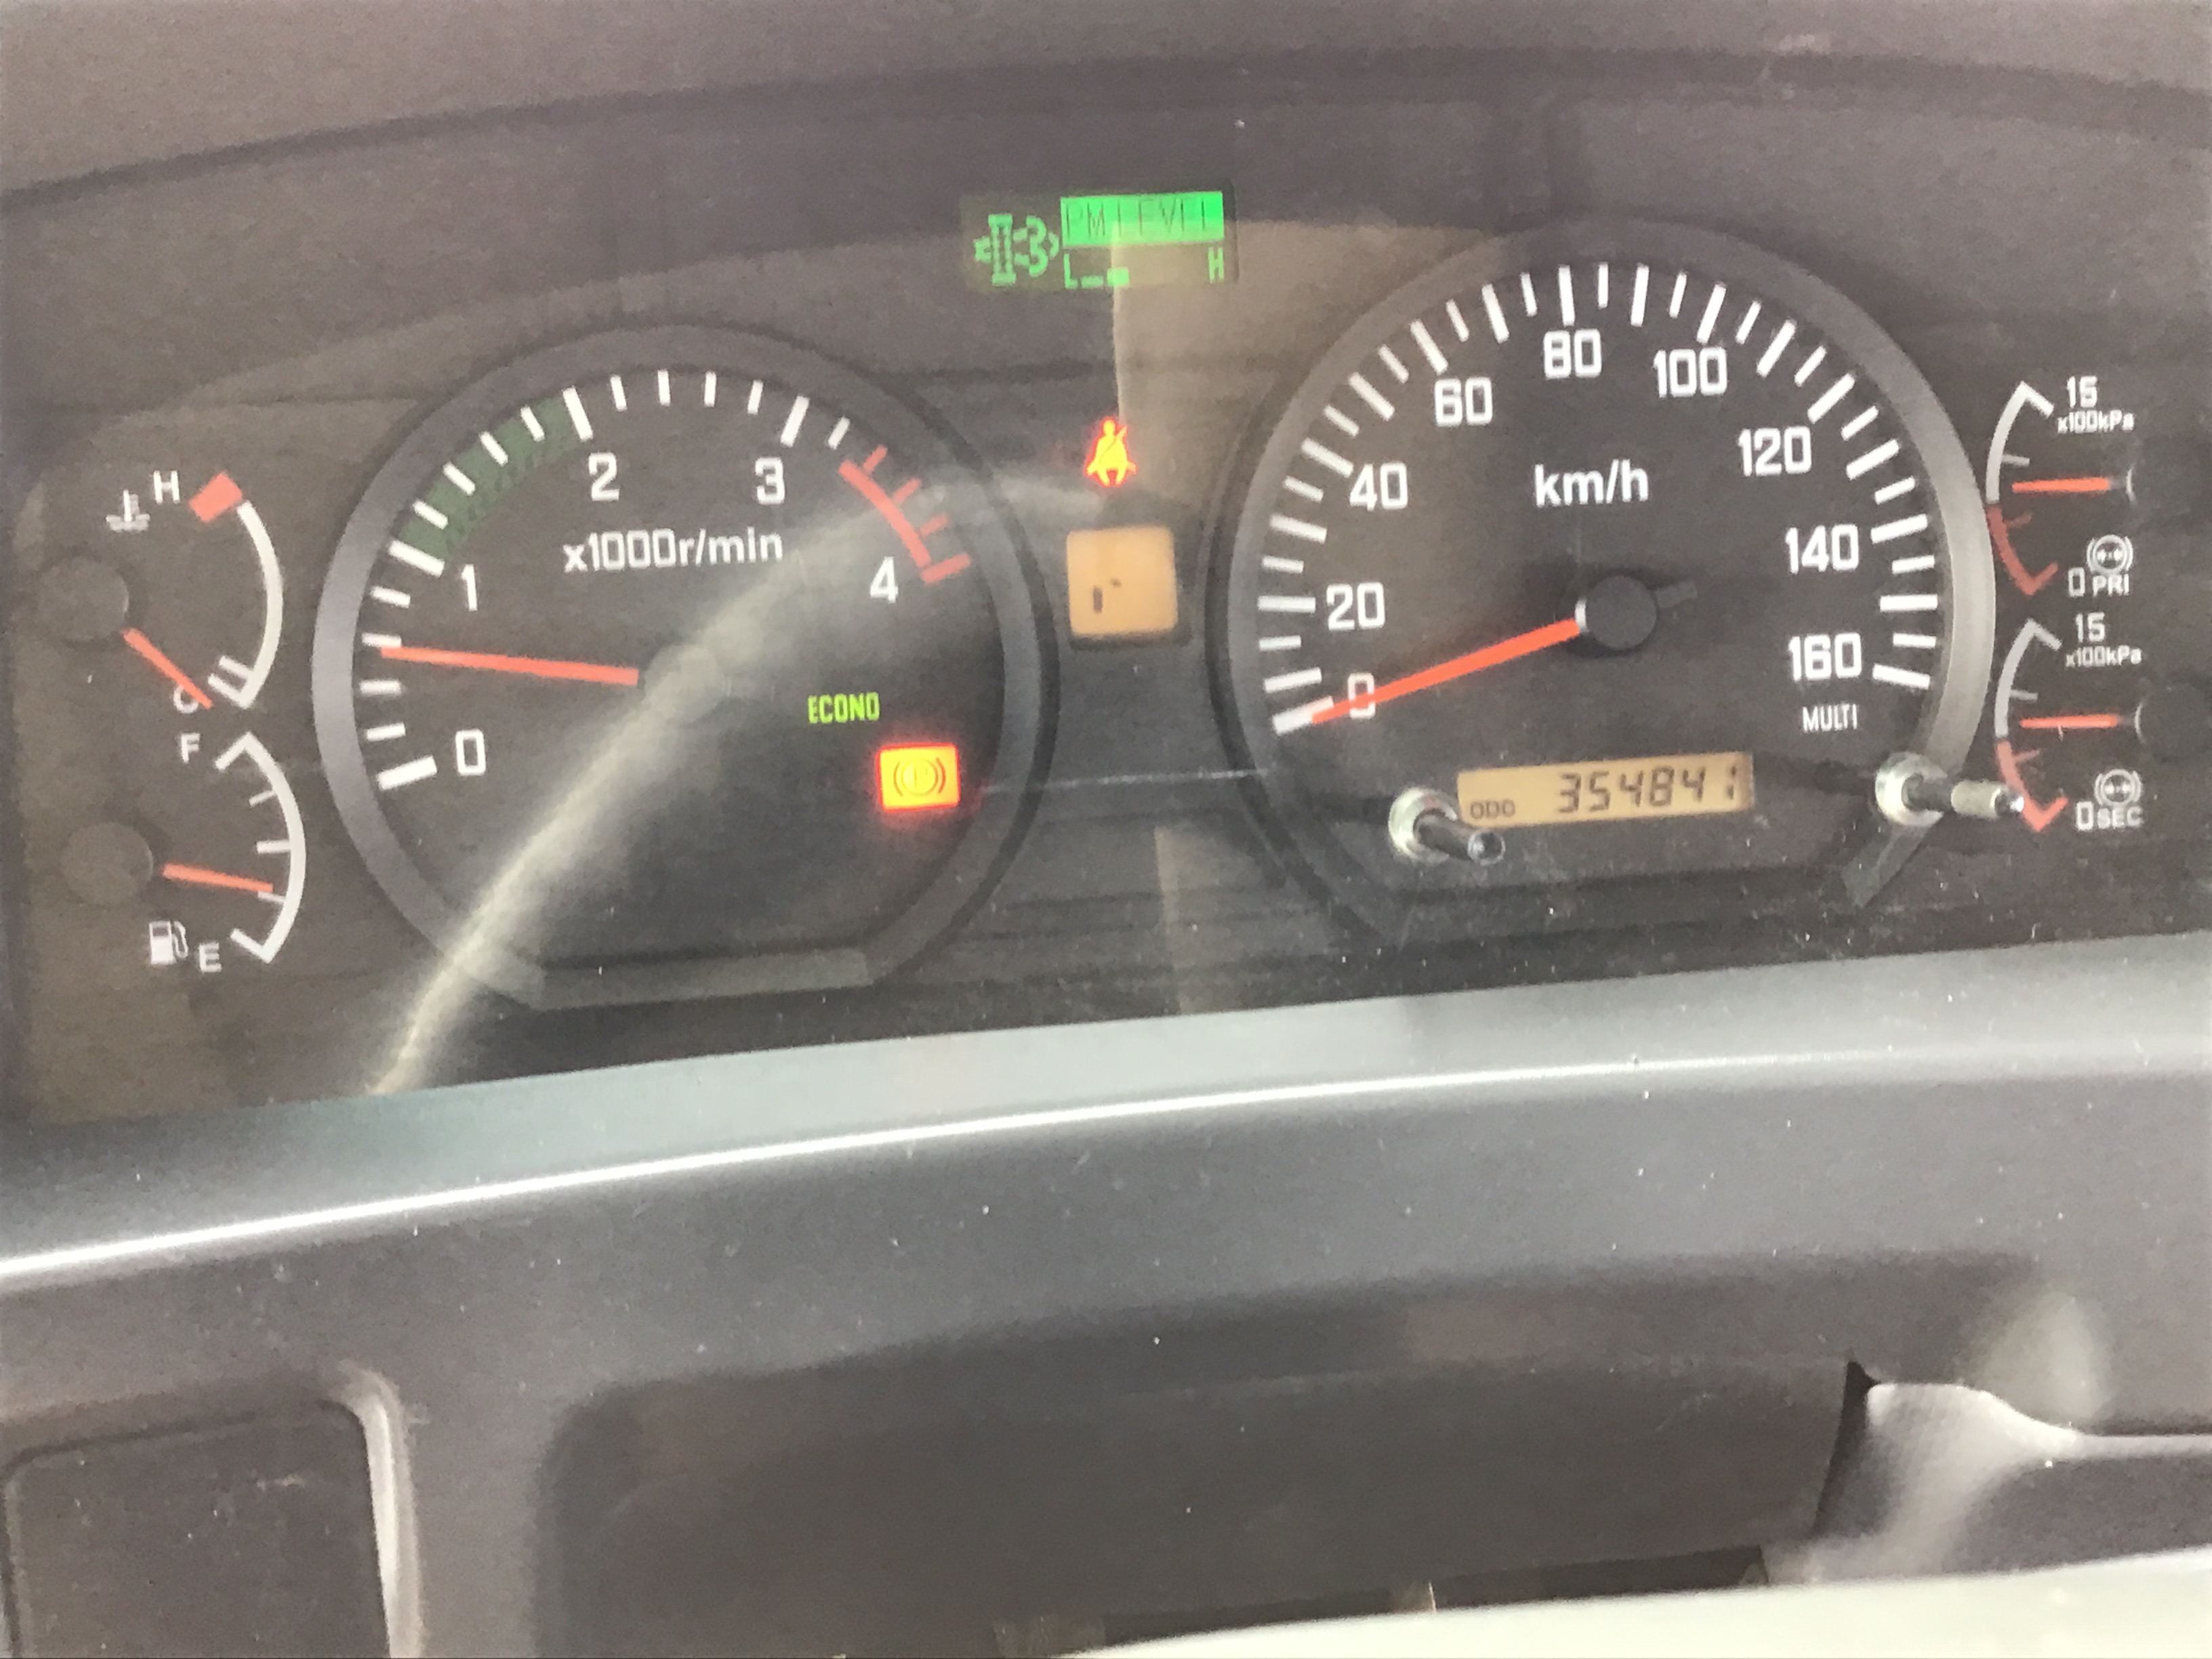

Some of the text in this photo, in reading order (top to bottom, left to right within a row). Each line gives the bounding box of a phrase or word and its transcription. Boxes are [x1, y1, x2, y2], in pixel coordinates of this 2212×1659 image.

[1208, 247, 1224, 284] H
[1543, 329, 1602, 380] 80
[1654, 347, 1728, 398] 100
[1434, 376, 1493, 428] 60
[2066, 375, 2098, 408] 15
[1738, 427, 1812, 476] 120
[152, 470, 180, 504] H
[588, 452, 620, 501] 2
[754, 457, 785, 505] 3
[1349, 462, 1409, 510] 40
[1534, 459, 1650, 508] km/h
[562, 527, 783, 574] x1000r/min
[1785, 523, 1860, 574] 140
[461, 563, 478, 612] 1
[869, 556, 899, 604] 4
[2093, 573, 2130, 597] PRI
[1326, 581, 1385, 631] 20
[2075, 611, 2106, 642] 15
[1788, 632, 1862, 682] 160
[2066, 644, 2142, 668] x100kPa
[806, 691, 881, 724] ECONO
[1348, 672, 1375, 720] 0
[1802, 703, 1858, 733] MULTI
[180, 732, 201, 764] F
[454, 728, 487, 776] 0
[1469, 764, 1737, 821] ODO 354841
[2097, 806, 2144, 830] SEC
[199, 942, 222, 972] E
